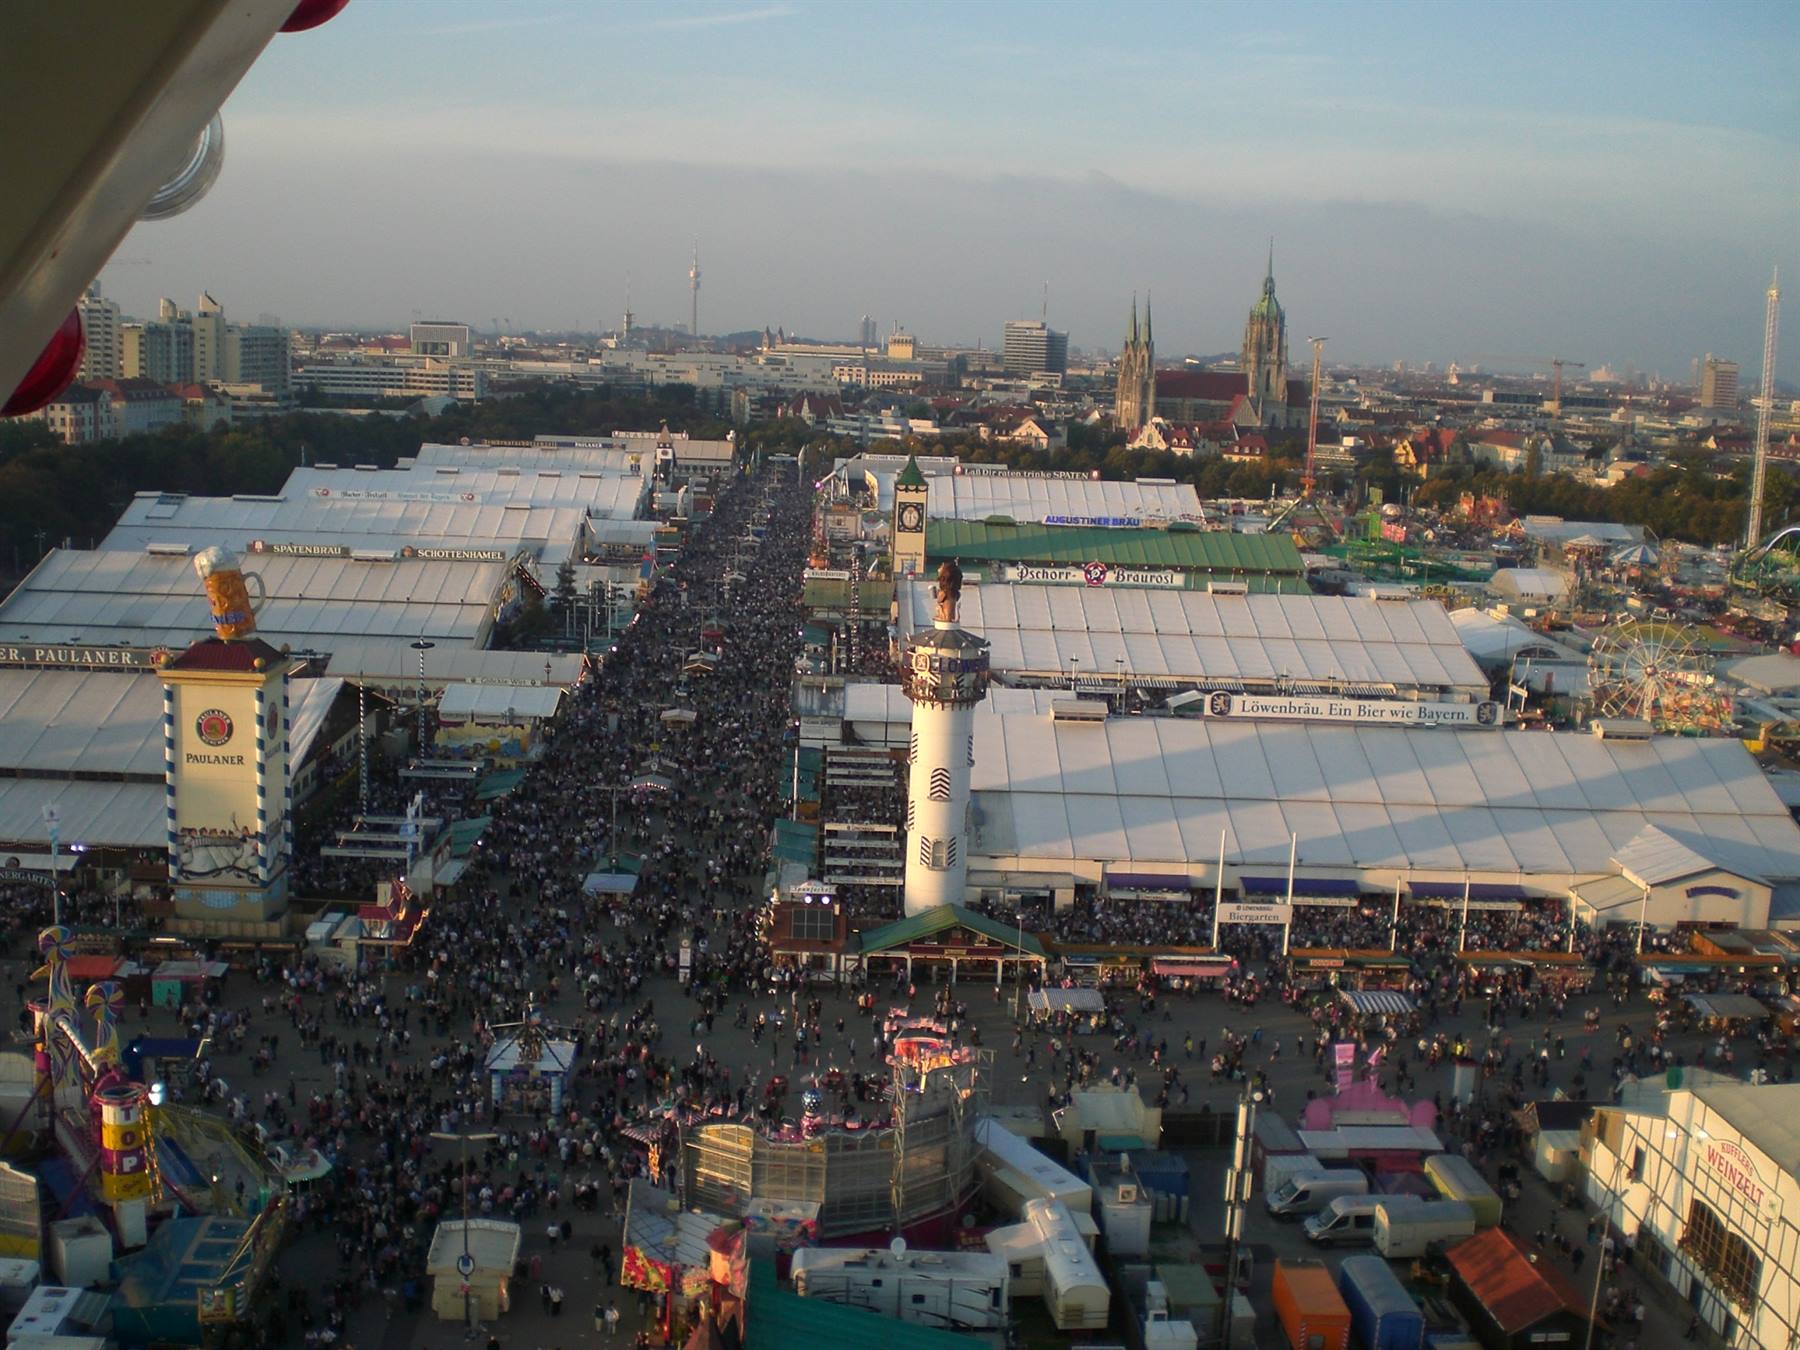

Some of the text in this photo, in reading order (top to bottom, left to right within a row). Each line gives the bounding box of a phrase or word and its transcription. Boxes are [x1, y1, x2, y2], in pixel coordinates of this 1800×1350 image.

[1045, 515, 1140, 527] AUGUSTINER BRÄU
[417, 549, 503, 560] SCHOTTENHAMEL
[198, 709, 231, 724] PAULANER
[1241, 700, 1469, 721] Löwenbräu. Ein Bier wie Bayern.
[186, 752, 245, 765] PAULANER
[1229, 911, 1279, 922] Biergarten
[1706, 1145, 1765, 1207] WEINZELT
